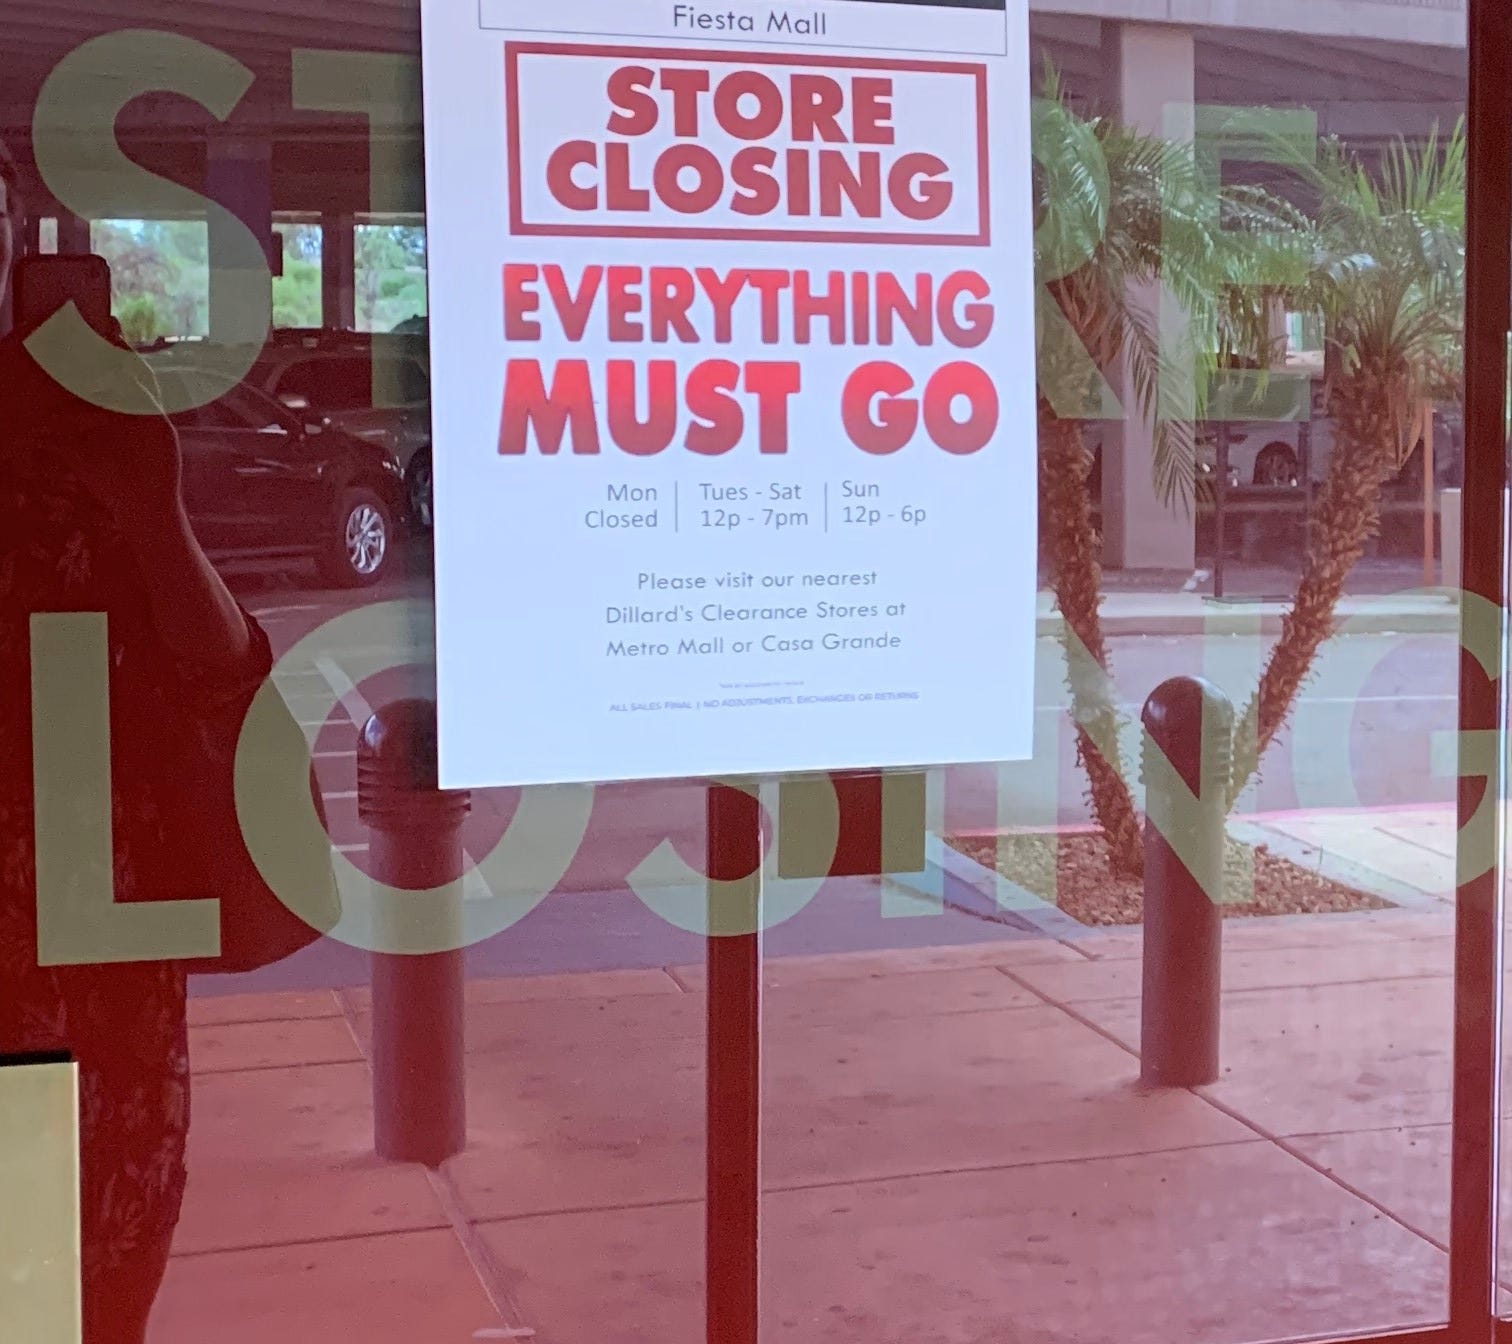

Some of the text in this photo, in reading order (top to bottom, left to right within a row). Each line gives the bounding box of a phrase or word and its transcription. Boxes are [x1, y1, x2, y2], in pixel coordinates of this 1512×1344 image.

[673, 4, 827, 35] Fiesta Mall
[605, 65, 895, 146] STORE
[546, 140, 954, 221] CLOSING
[503, 263, 995, 349] EVERYTHING
[498, 359, 999, 457] MUST GO
[606, 483, 658, 502] Mon
[699, 482, 749, 501] Tues
[768, 482, 803, 501] Sat
[841, 479, 880, 498] Sun
[584, 508, 658, 529] Closed
[700, 508, 741, 531] 12p
[762, 508, 809, 530] 7pm
[842, 505, 881, 527] 12p
[900, 504, 927, 527] 6p
[637, 570, 878, 591] Please visit our nearest
[606, 600, 907, 624] Dillard's Clearance Stores at
[606, 631, 902, 657] Metro Mall or Casa Grande
